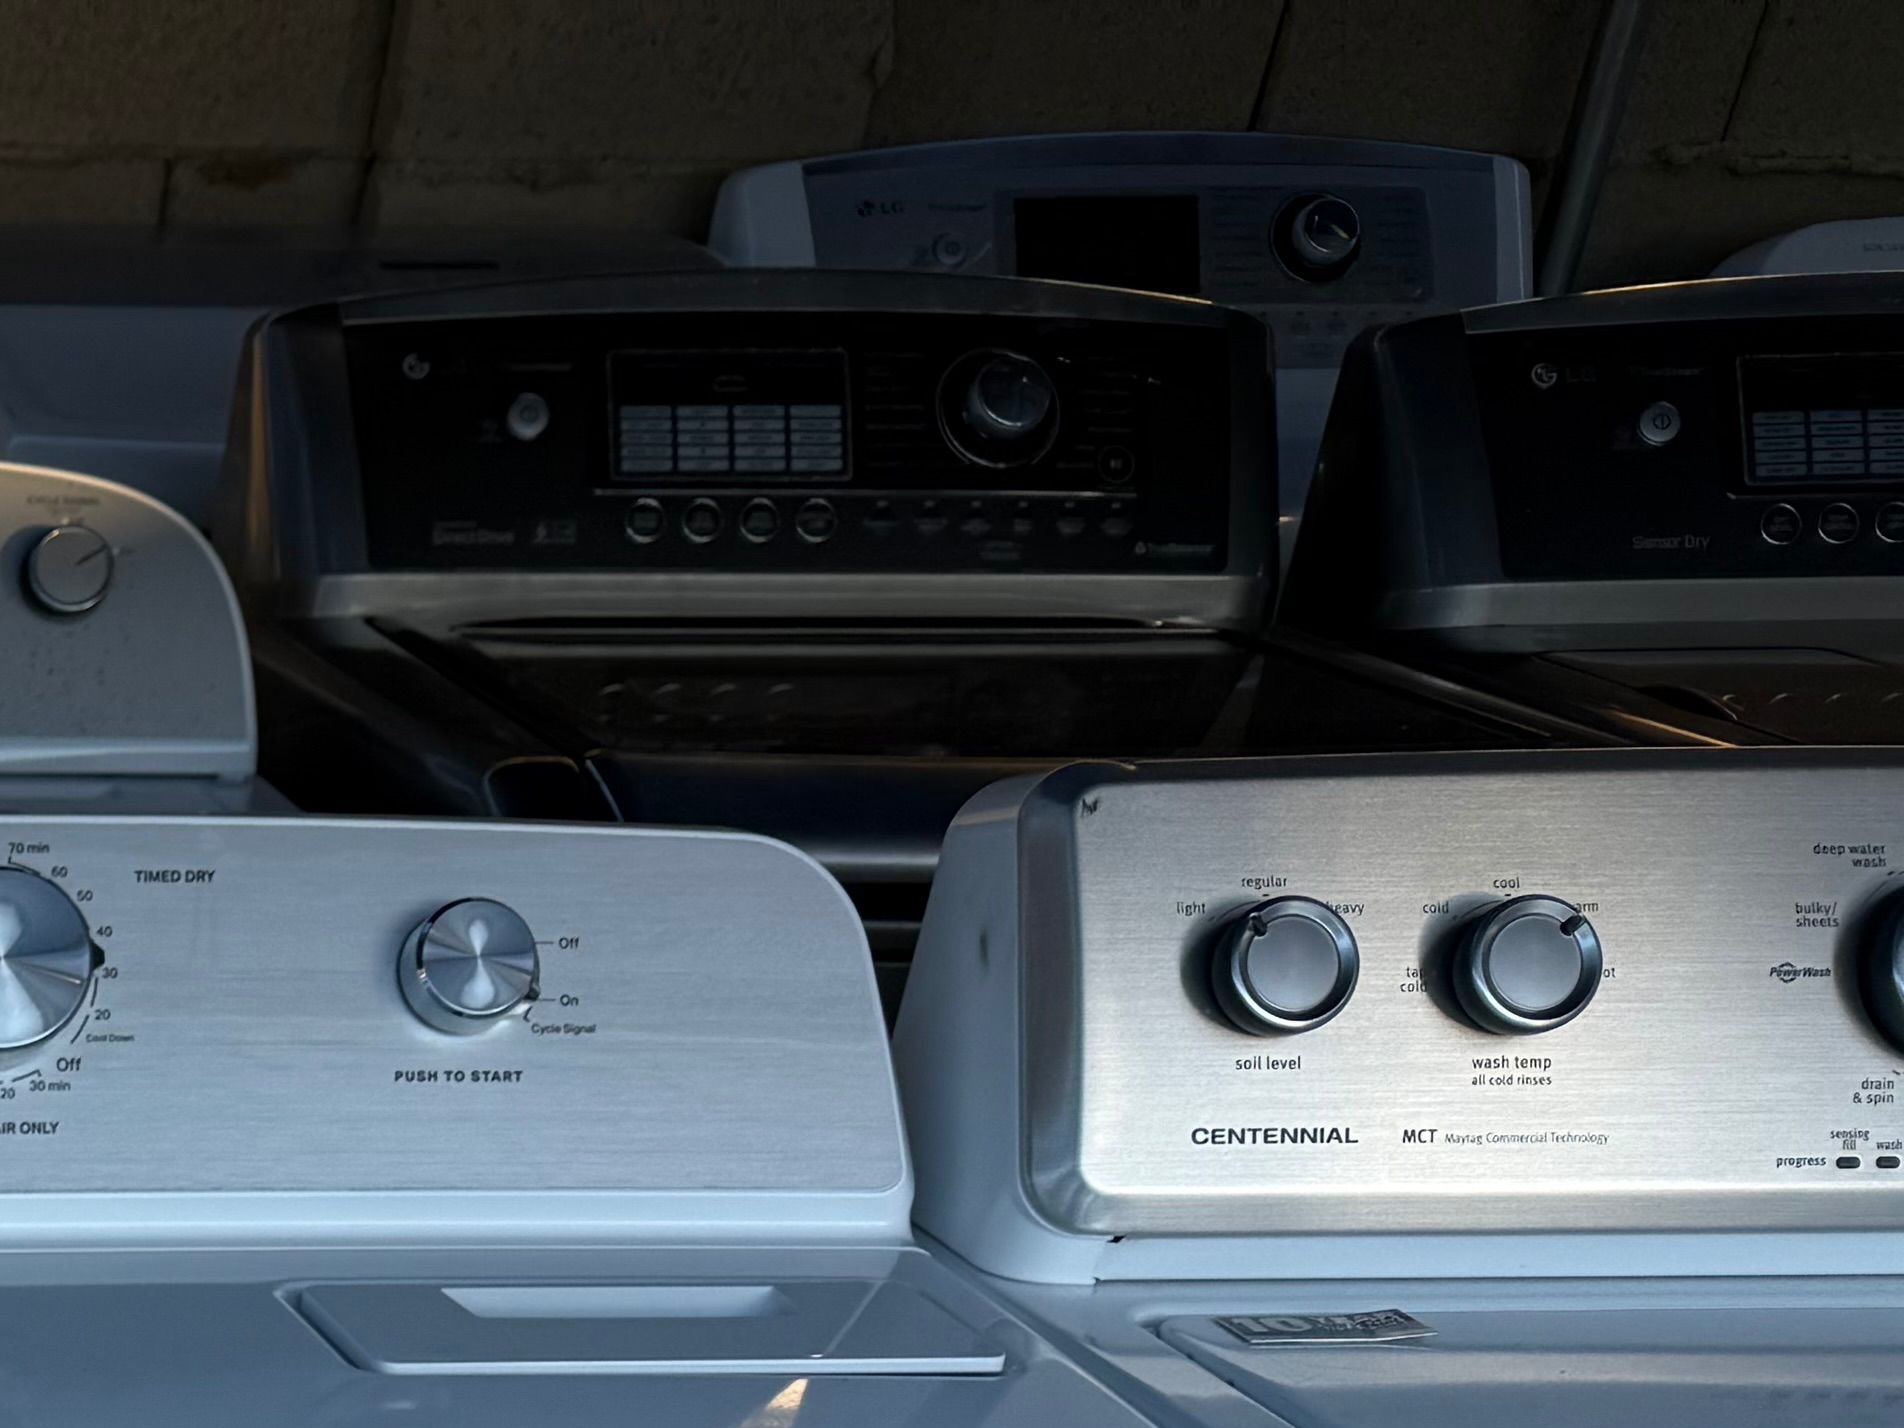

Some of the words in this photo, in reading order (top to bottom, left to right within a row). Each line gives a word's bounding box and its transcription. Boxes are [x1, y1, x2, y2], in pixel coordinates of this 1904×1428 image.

[1685, 535, 1709, 549] Dry
[9, 842, 24, 854] 70
[27, 843, 50, 853] min
[134, 870, 181, 883] TIMED
[185, 870, 215, 883] DRY
[1242, 875, 1287, 890] regular
[1493, 877, 1519, 888] cool
[1177, 901, 1206, 916] light
[1423, 901, 1449, 914] cold
[1795, 902, 1837, 916] bulky/
[1796, 915, 1840, 927] sheets
[97, 926, 112, 937] 40
[559, 938, 579, 949] Off
[103, 967, 118, 978] 30
[1770, 967, 1831, 978] PowerWash
[560, 994, 579, 1006] On
[95, 1009, 111, 1020] 20
[531, 1023, 561, 1035] Cycle
[563, 1023, 596, 1035] Signal
[57, 1057, 81, 1072] Off
[1236, 1056, 1261, 1070] soil
[1267, 1056, 1300, 1069] level
[1472, 1055, 1509, 1069] wash
[1515, 1056, 1551, 1071] temp
[395, 1070, 437, 1082] PUSH
[444, 1071, 465, 1082] TO
[471, 1070, 523, 1082] START
[1472, 1074, 1485, 1085] all
[1489, 1075, 1513, 1085] cold
[1518, 1075, 1552, 1085] rinses
[0, 1088, 15, 1099] 20
[30, 1080, 46, 1092] 30
[48, 1080, 71, 1091] min
[1862, 1077, 1894, 1090] drain
[1853, 1092, 1862, 1103] &
[1867, 1094, 1893, 1106] spin
[20, 1122, 59, 1134] ONLY
[1192, 1128, 1358, 1144] CENTENNIAL
[1403, 1129, 1437, 1143] MCT
[1445, 1134, 1482, 1145] Maytag
[1486, 1132, 1547, 1143] Commercial
[1551, 1132, 1610, 1145] Technology
[1777, 1157, 1826, 1168] progress
